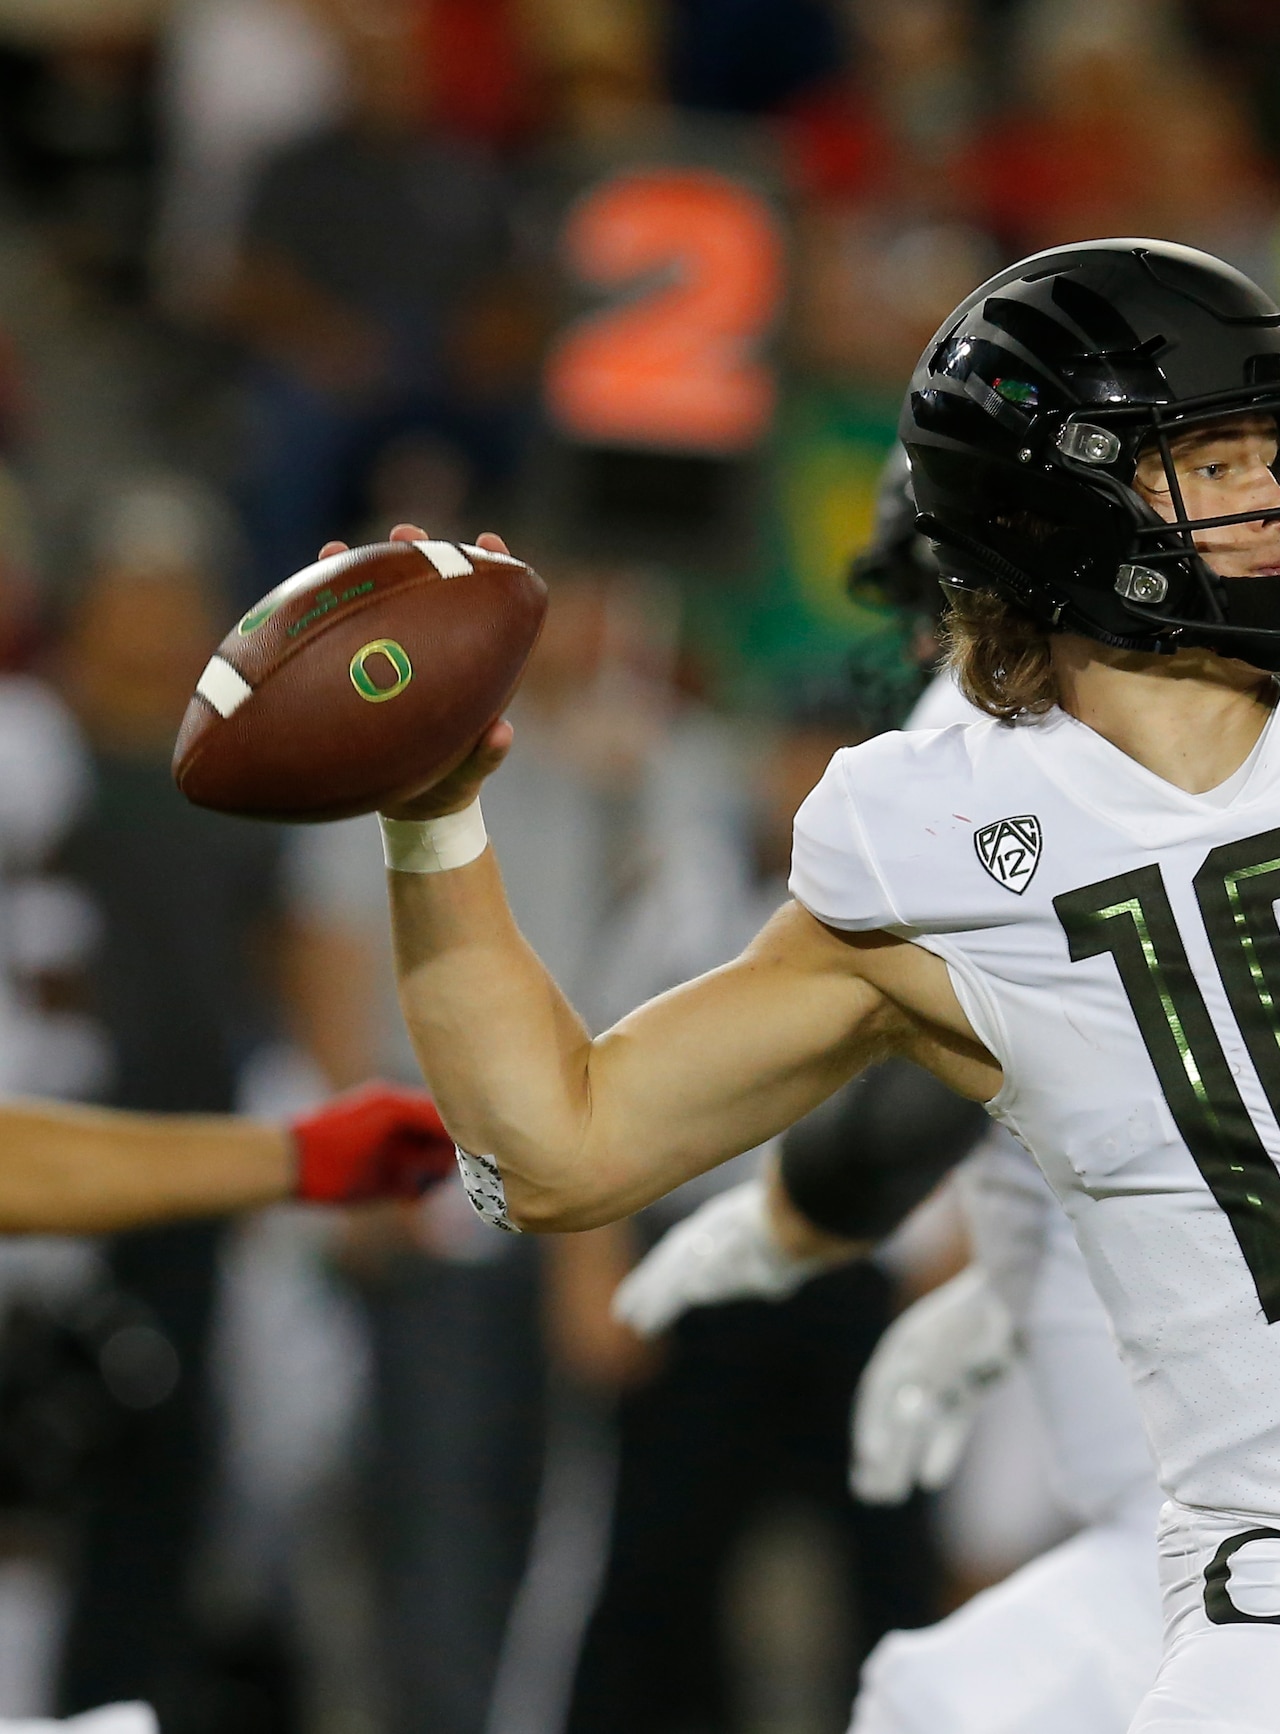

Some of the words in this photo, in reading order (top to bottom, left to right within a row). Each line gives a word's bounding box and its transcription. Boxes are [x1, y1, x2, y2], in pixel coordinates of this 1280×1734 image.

[546, 168, 784, 446] 2
[979, 818, 1037, 870] PAC
[997, 848, 1030, 881] 12
